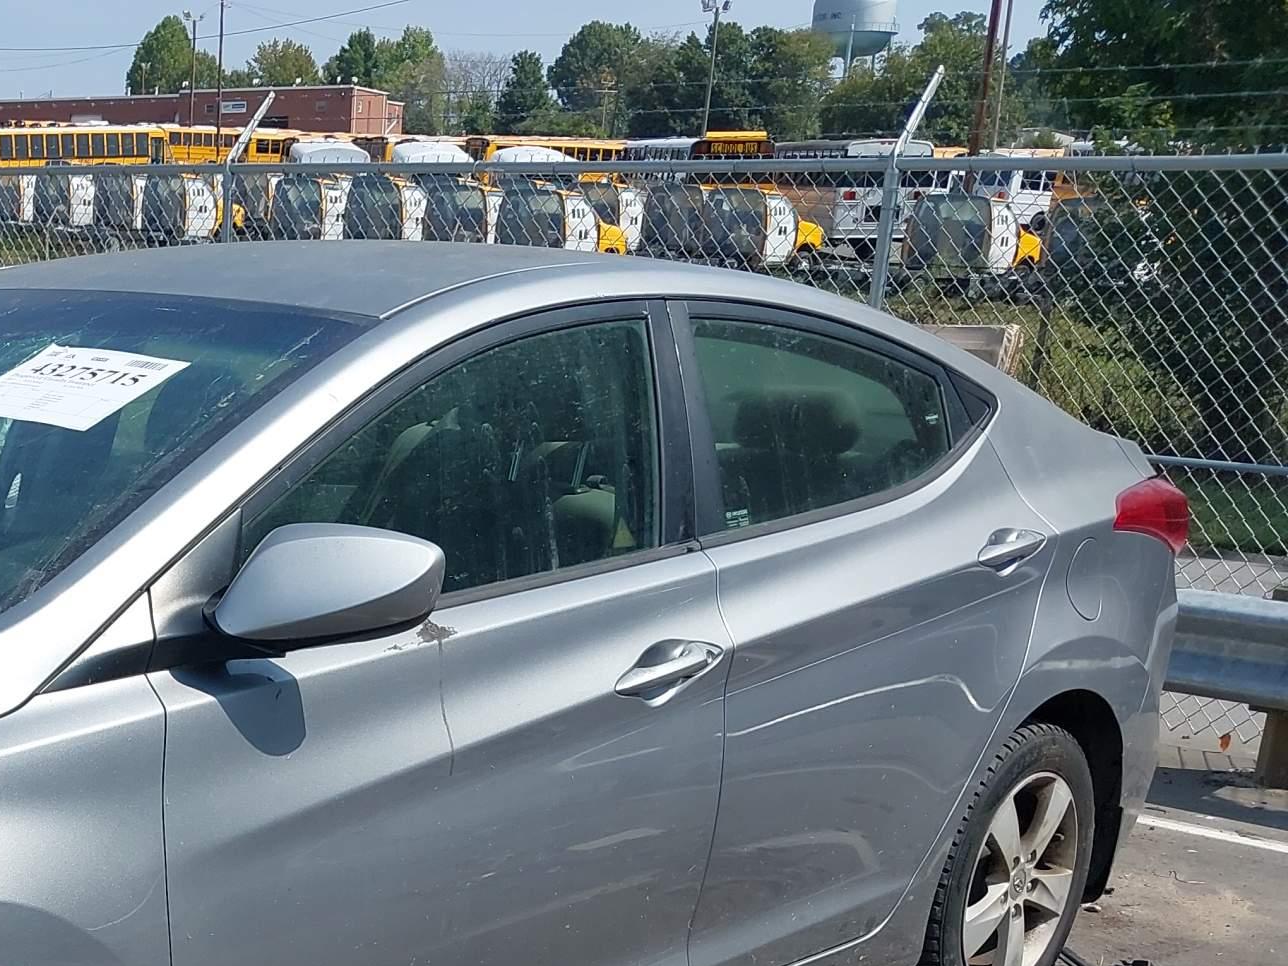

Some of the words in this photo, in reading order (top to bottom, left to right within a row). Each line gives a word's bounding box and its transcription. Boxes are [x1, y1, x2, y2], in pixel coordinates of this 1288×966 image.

[712, 143, 739, 153] SCHOOL
[743, 143, 757, 153] BUS
[32, 362, 147, 387] 43275715
